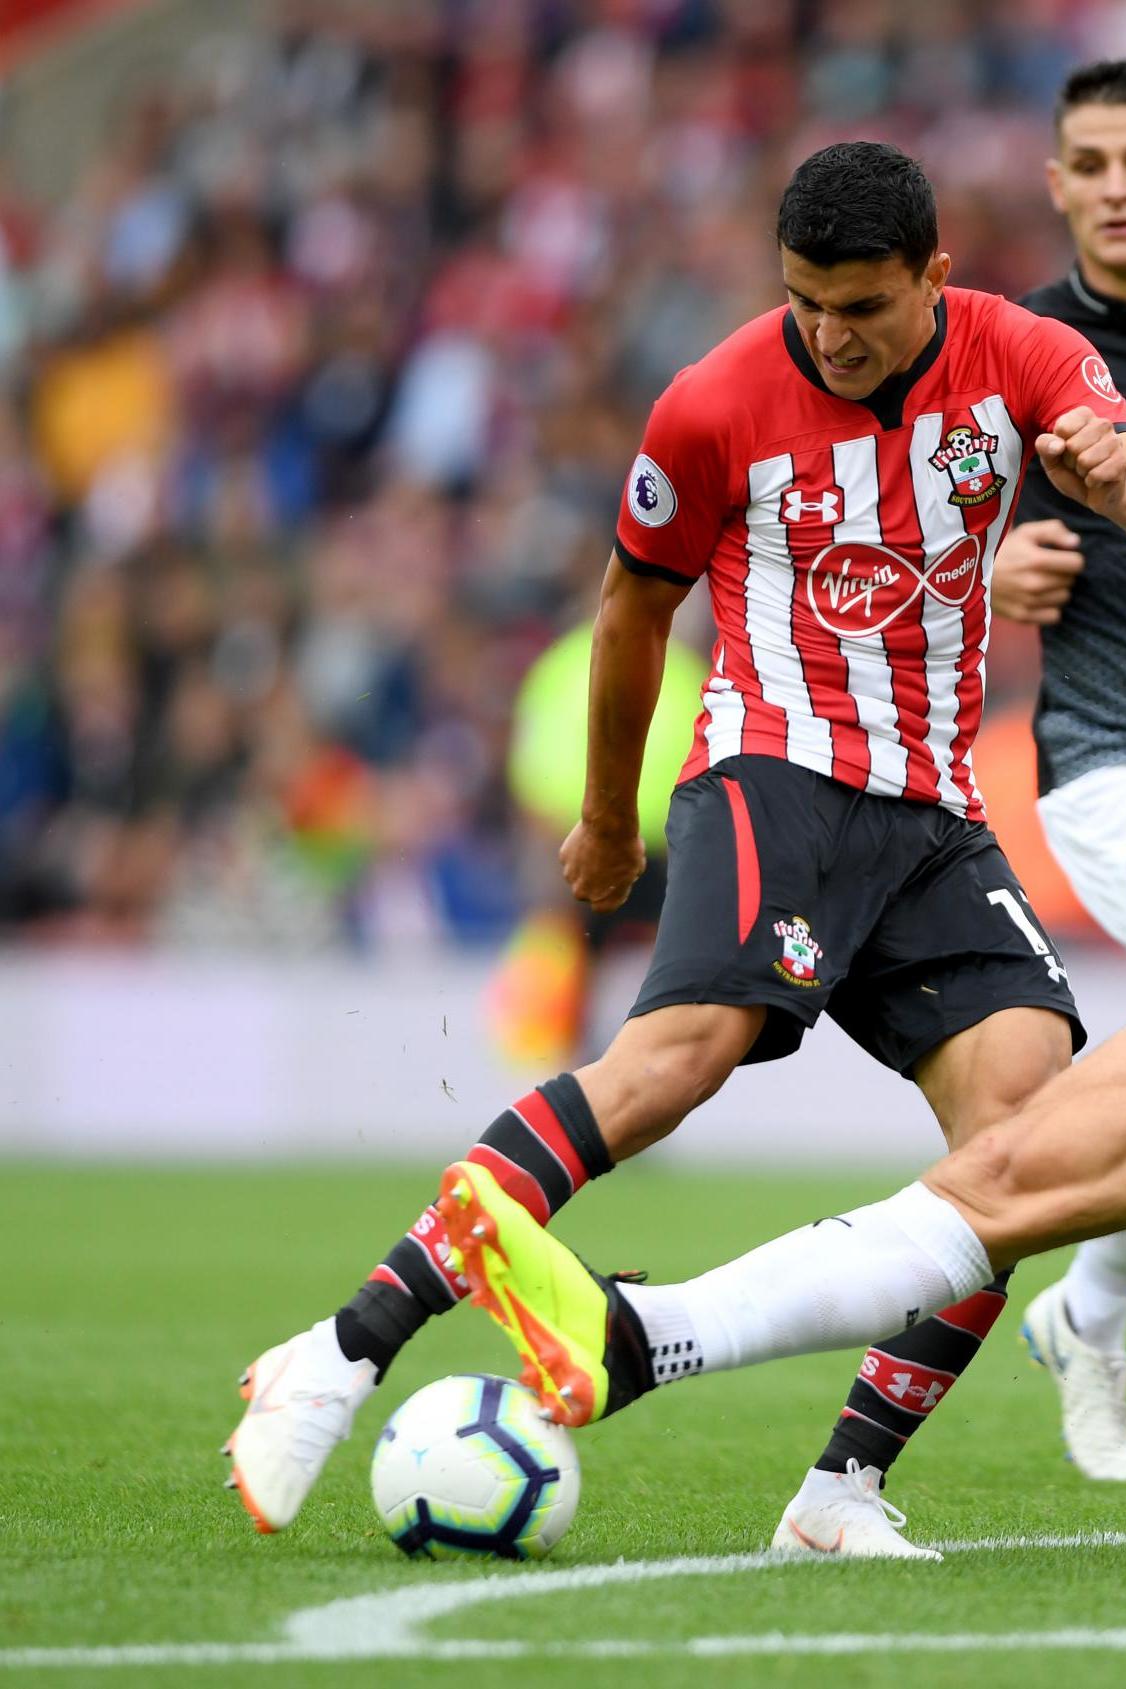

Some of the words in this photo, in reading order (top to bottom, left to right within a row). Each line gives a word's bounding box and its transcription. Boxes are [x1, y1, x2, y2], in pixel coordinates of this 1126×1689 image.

[951, 487, 996, 505] SOUTHAMPTON
[822, 558, 900, 618] Virgin
[935, 556, 976, 584] media
